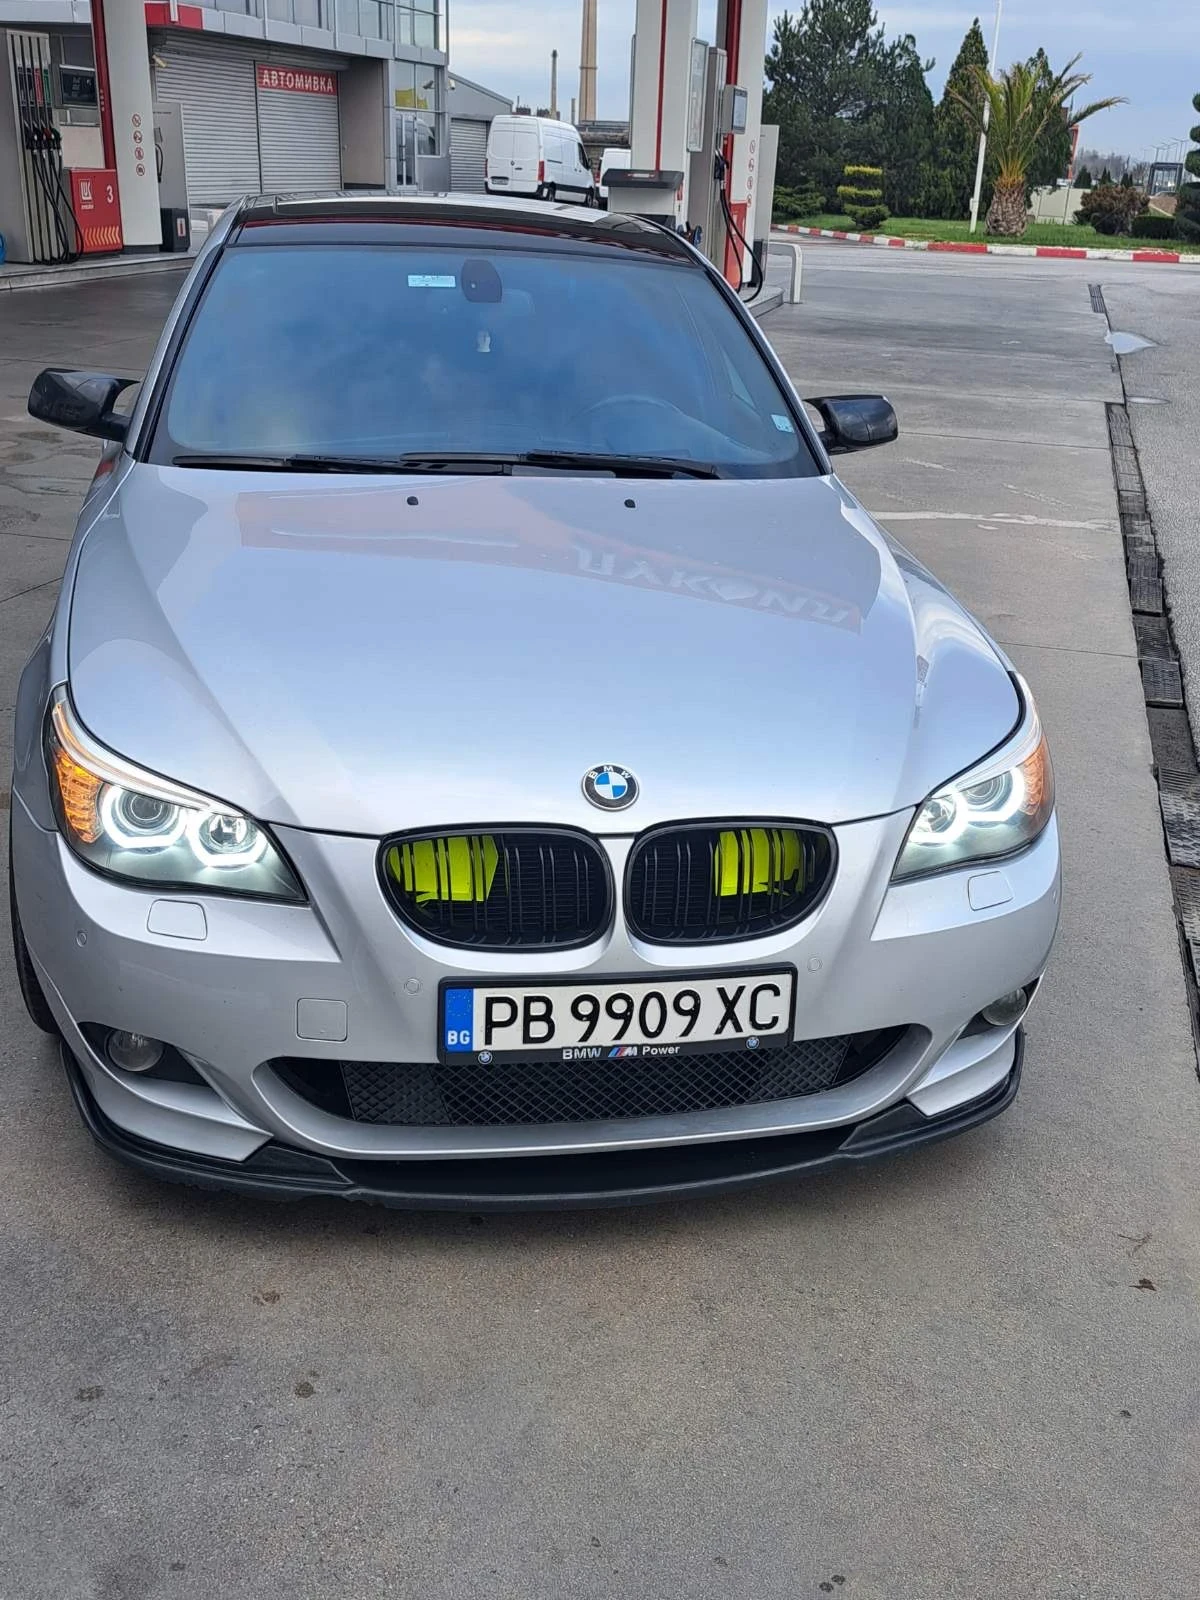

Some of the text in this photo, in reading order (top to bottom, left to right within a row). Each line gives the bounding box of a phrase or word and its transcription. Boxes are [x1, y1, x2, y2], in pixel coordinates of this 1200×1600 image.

[263, 70, 333, 92] АВТОМИВКА
[106, 185, 114, 203] 3
[587, 765, 631, 779] BMW
[484, 983, 781, 1045] PB 9909 XC
[448, 1030, 470, 1045] BG
[562, 1047, 602, 1060] BMW
[642, 1045, 680, 1056] Power
